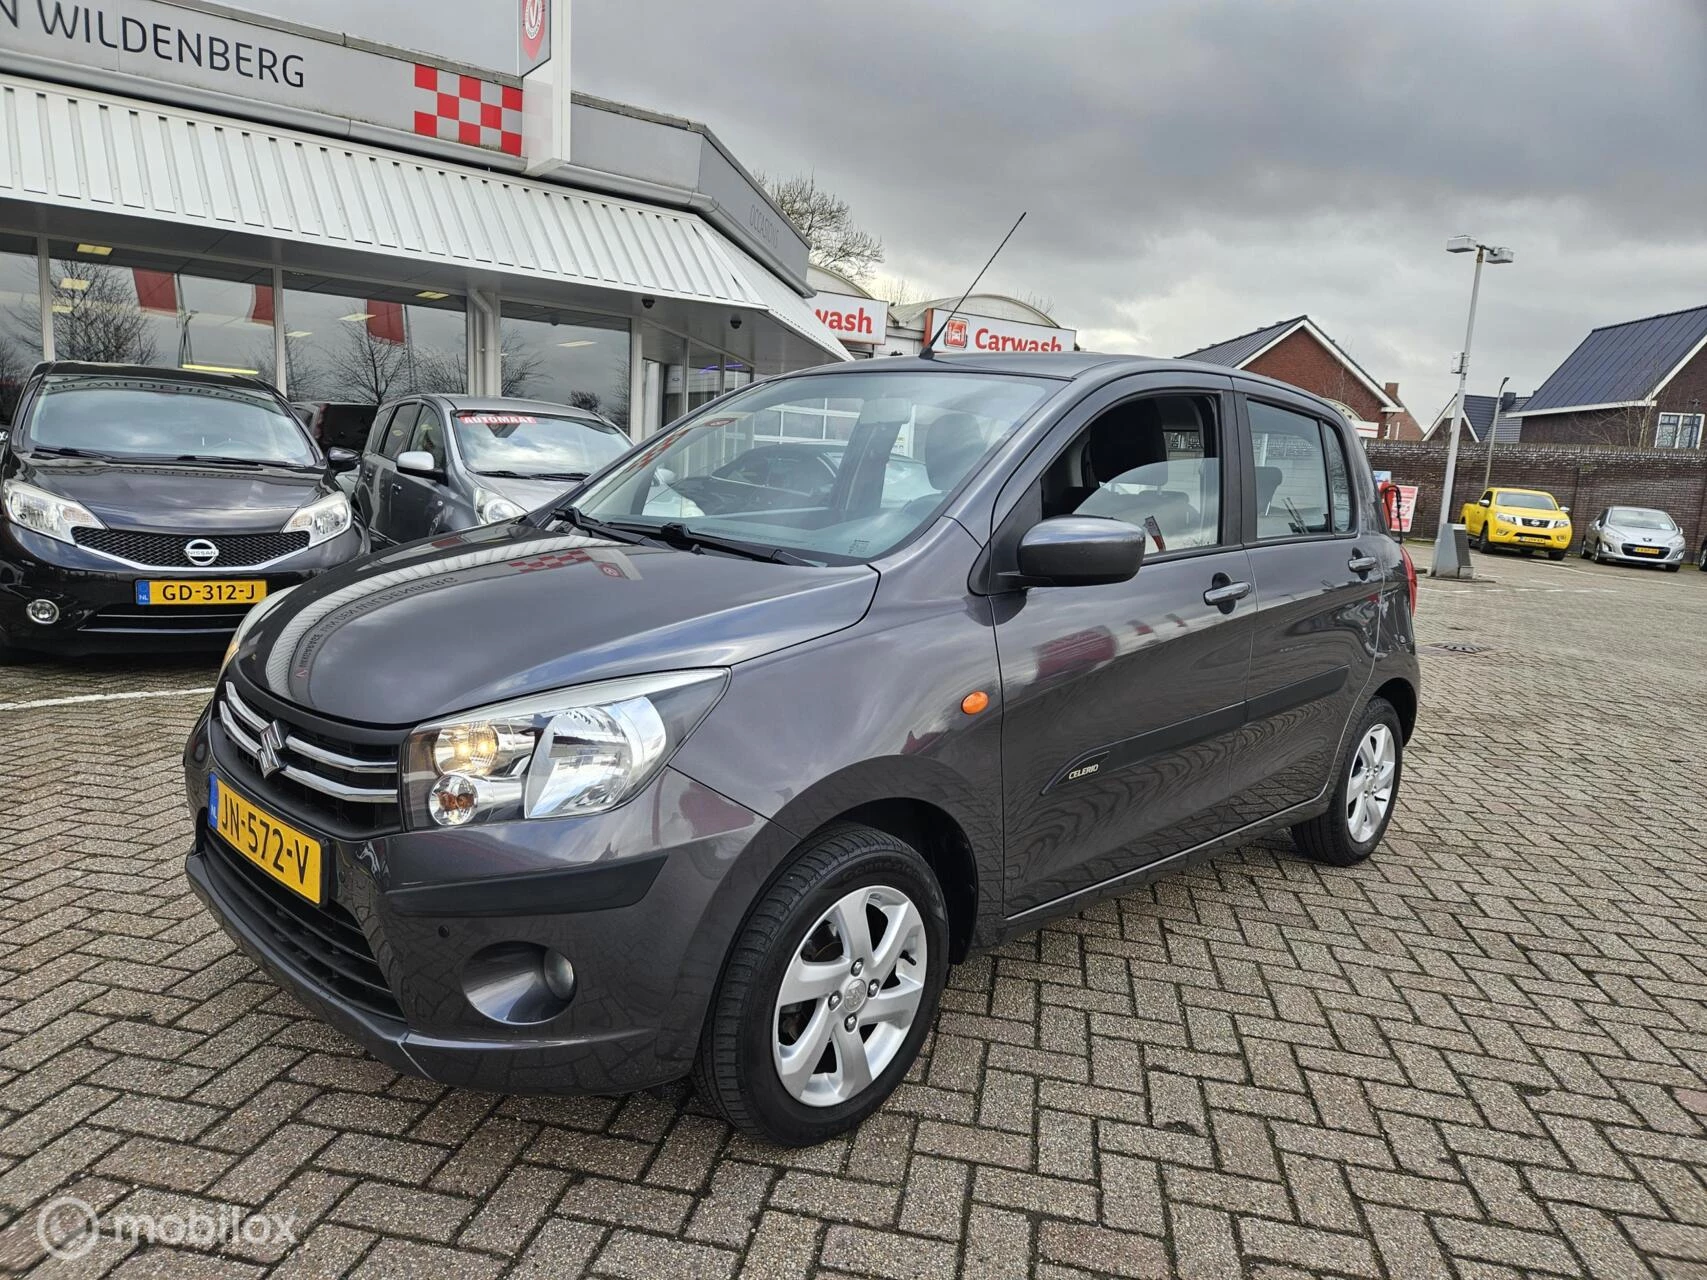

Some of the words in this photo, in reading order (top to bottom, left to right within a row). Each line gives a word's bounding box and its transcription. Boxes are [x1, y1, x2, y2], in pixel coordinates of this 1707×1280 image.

[37, 0, 304, 88] WILDENBERG
[975, 328, 1062, 353] Carwash
[464, 416, 537, 424] AUTOMAAT
[162, 584, 256, 602] GD-312-J
[1068, 763, 1099, 780] CELERIO
[210, 805, 218, 820] NL
[222, 793, 310, 885] JN-572-V
